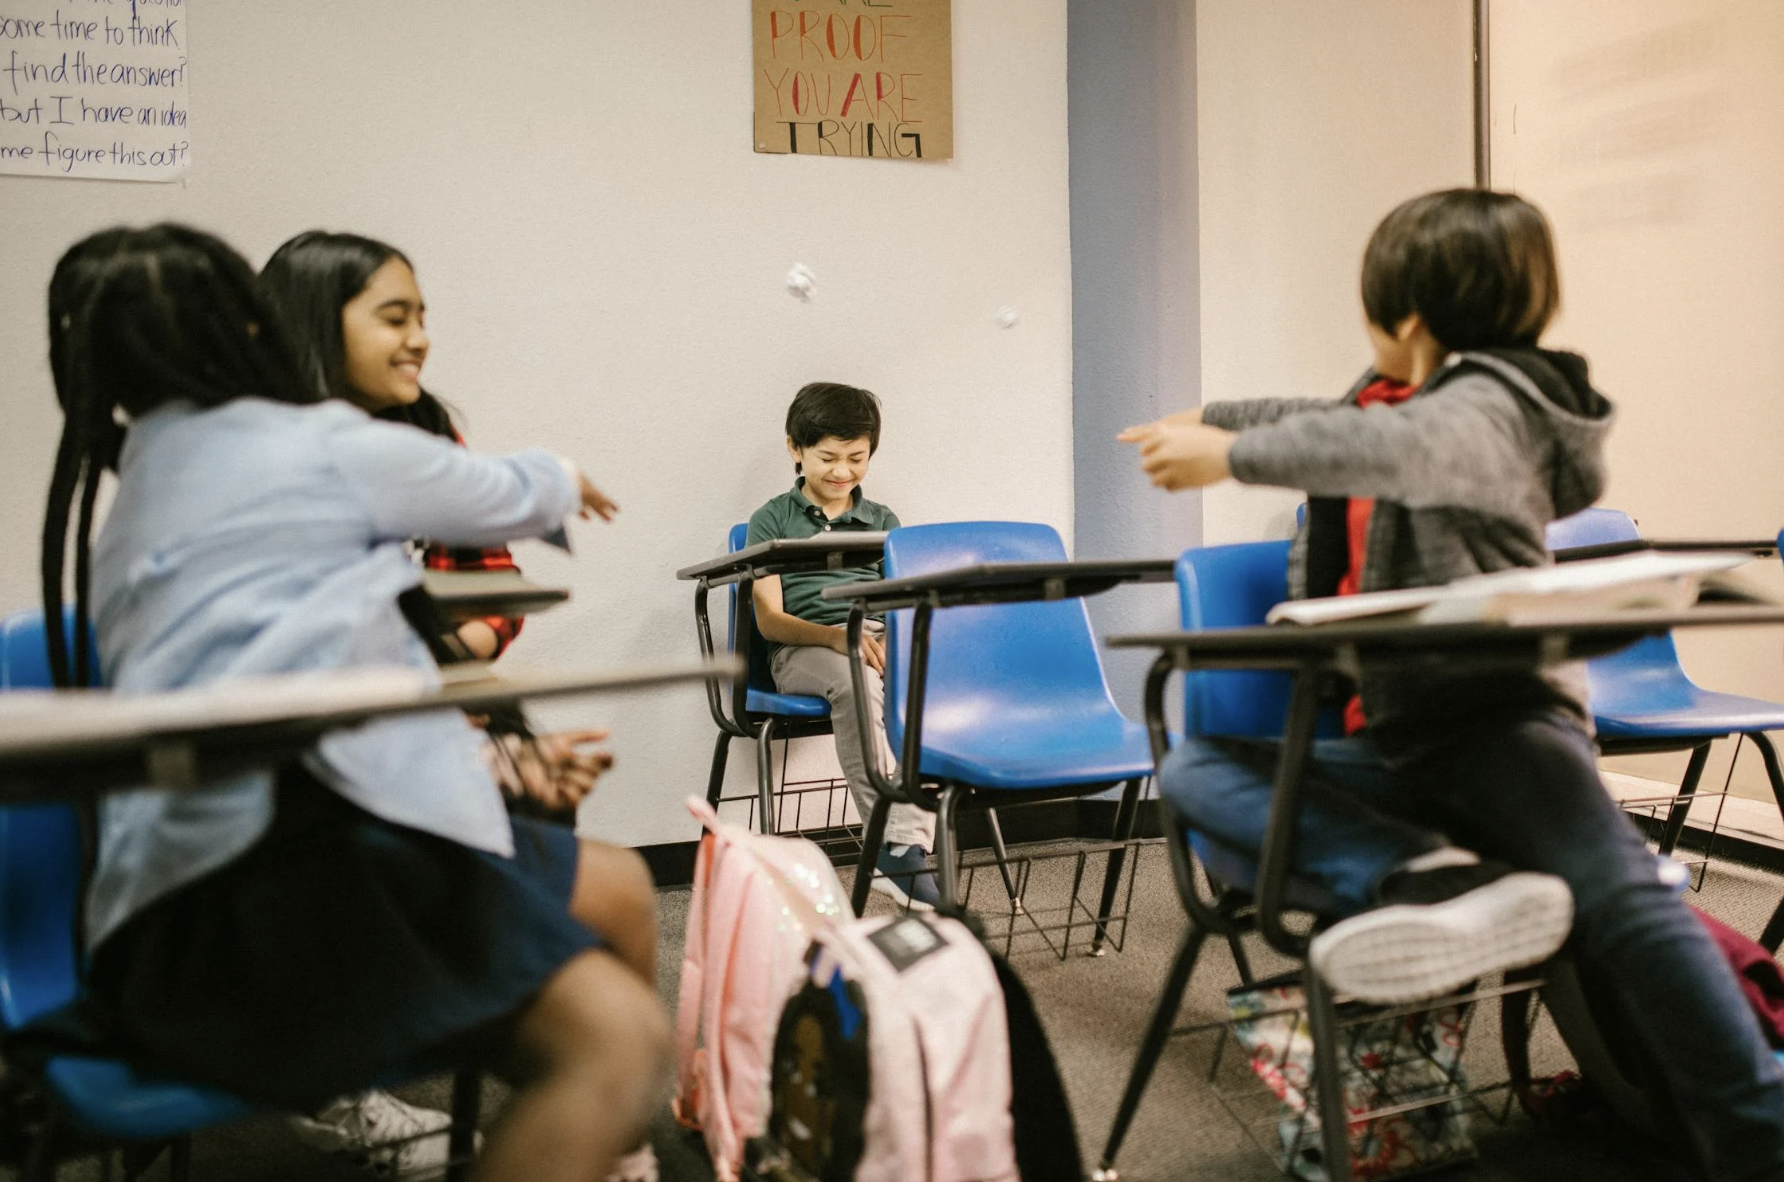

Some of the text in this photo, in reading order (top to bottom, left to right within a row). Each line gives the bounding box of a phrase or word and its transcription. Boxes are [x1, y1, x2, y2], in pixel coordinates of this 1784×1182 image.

[50, 10, 98, 40] time
[105, 16, 124, 46] to
[128, 16, 178, 47] think
[770, 10, 911, 63] PROOF
[3, 50, 188, 96] find the answer?
[0, 96, 187, 129] but I have an idea
[763, 67, 924, 123] YOU ARE
[0, 146, 34, 159] me
[38, 131, 105, 173] figure
[108, 142, 147, 166] this
[775, 119, 922, 158] TRYING
